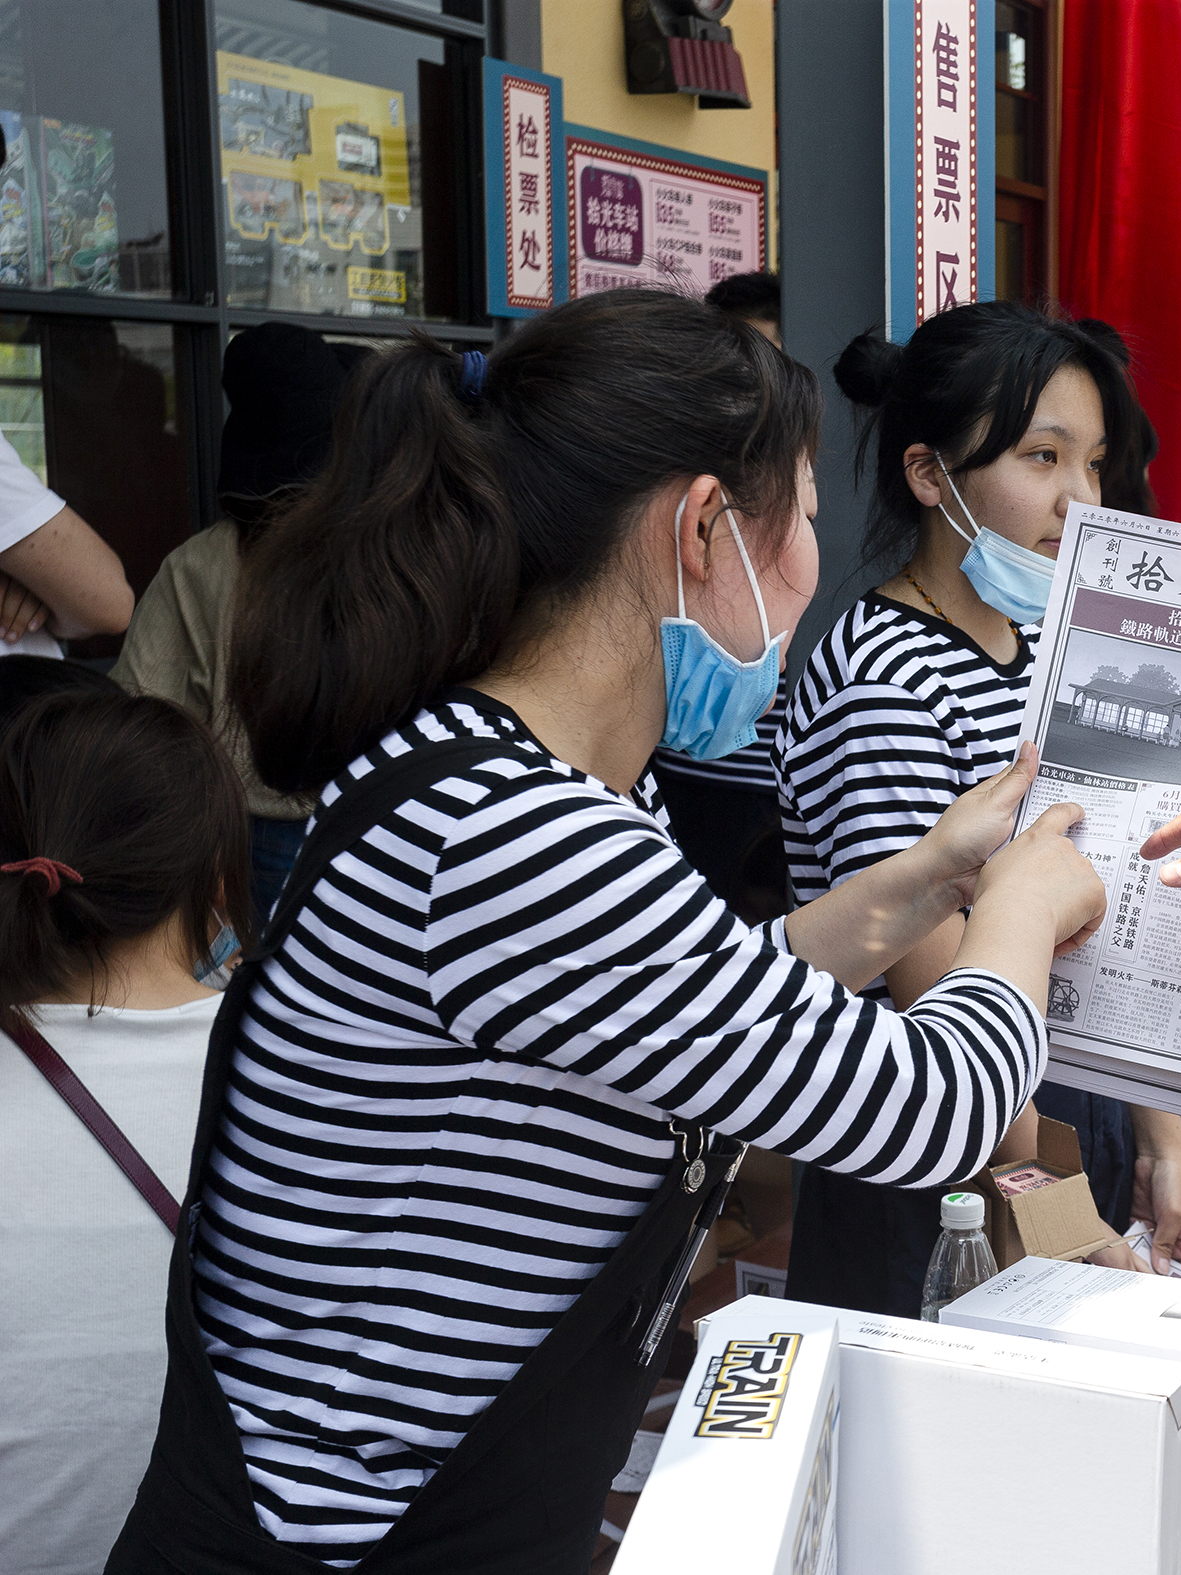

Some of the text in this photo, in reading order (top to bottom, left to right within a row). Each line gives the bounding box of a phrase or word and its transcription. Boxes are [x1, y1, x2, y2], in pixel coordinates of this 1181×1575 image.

[516, 113, 542, 271] 检票处
[933, 20, 961, 313] 售票区
[586, 196, 640, 233] 拾光车站
[1081, 512, 1180, 537] 二零二零年六月六日 星期六
[1098, 538, 1122, 590] 創刊號
[694, 1332, 803, 1439] TRAIN
